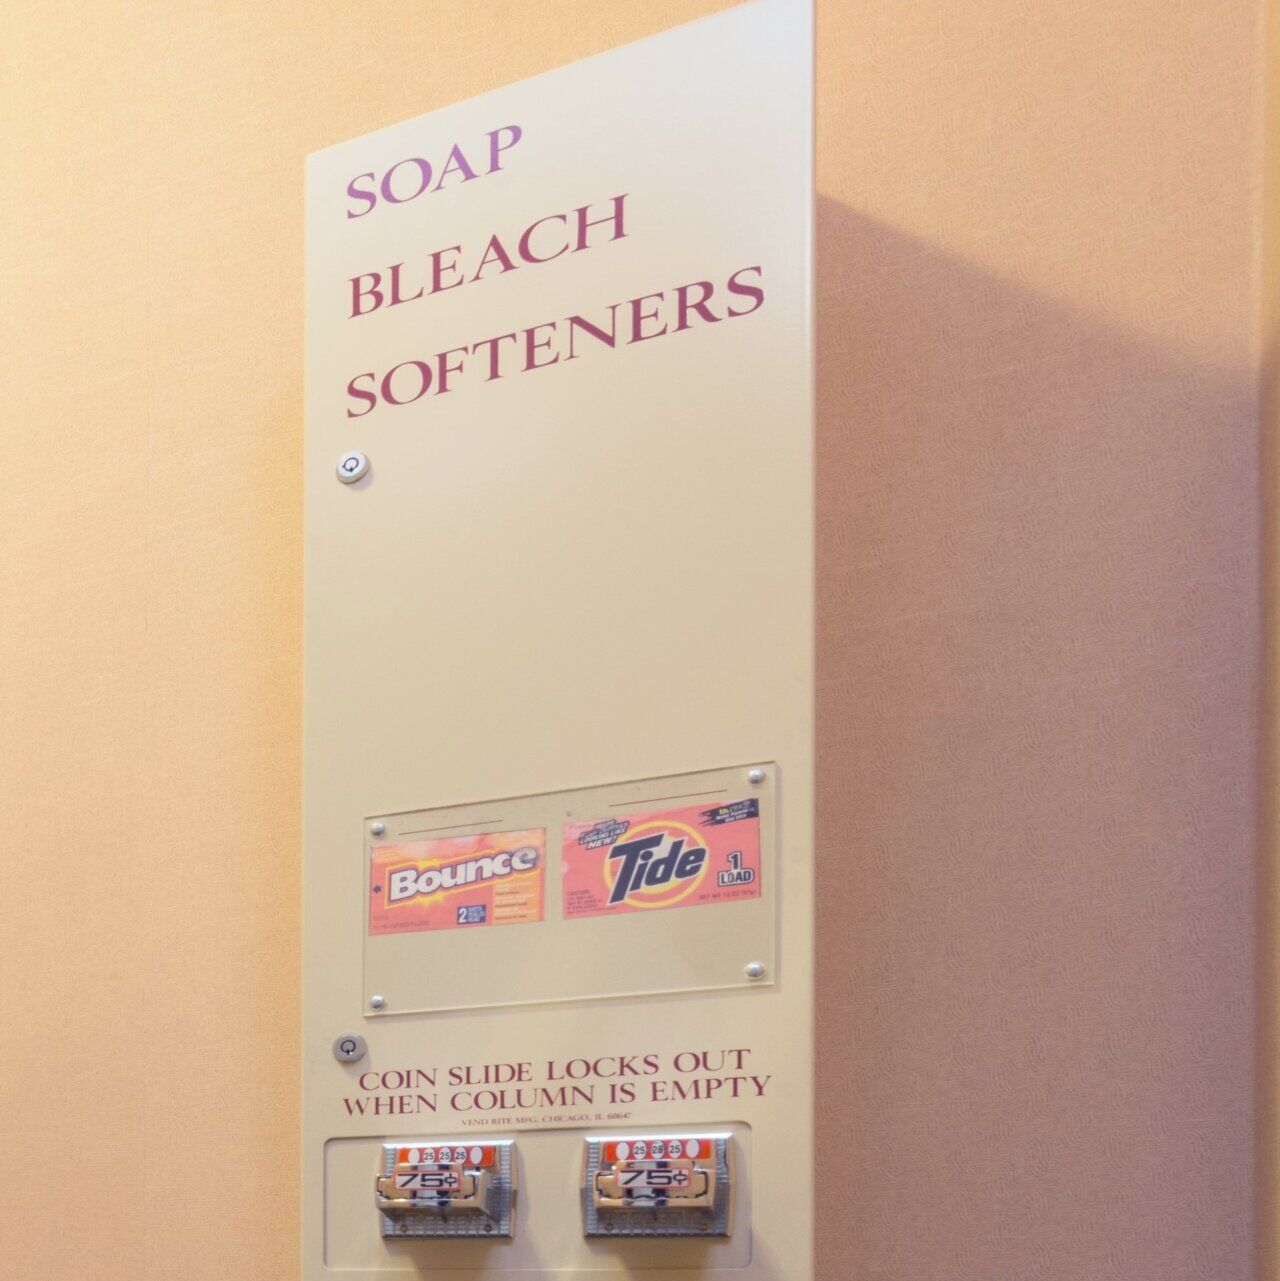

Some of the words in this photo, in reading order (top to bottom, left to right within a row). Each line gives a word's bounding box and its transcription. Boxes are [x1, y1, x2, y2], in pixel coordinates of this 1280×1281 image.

[346, 124, 523, 220] SOAP
[347, 192, 630, 319] BLEACH
[346, 265, 766, 418] SOFTENERS
[588, 835, 616, 849] NEW!
[608, 832, 707, 904] Tide
[728, 852, 741, 870] 1
[390, 846, 538, 901] Bounce
[720, 870, 752, 884] LOAD
[458, 907, 467, 923] 2
[359, 1066, 438, 1092] COIN
[448, 1062, 533, 1087] SLIDE
[546, 1053, 659, 1082] LOCKS
[673, 1048, 752, 1074] OUT
[343, 1092, 439, 1117] WHEN
[450, 1083, 597, 1113] COLUMN
[609, 1081, 636, 1105] IS
[650, 1074, 774, 1103] EMPTY
[462, 1118, 489, 1126] VEND
[491, 1117, 512, 1125] RITE
[424, 1152, 434, 1160] 25
[440, 1151, 450, 1160] 25
[455, 1151, 466, 1159] 25
[634, 1146, 645, 1155] 25
[669, 1145, 681, 1154] 25
[397, 1172, 458, 1188] 75¢
[620, 1169, 688, 1186] 75¢
